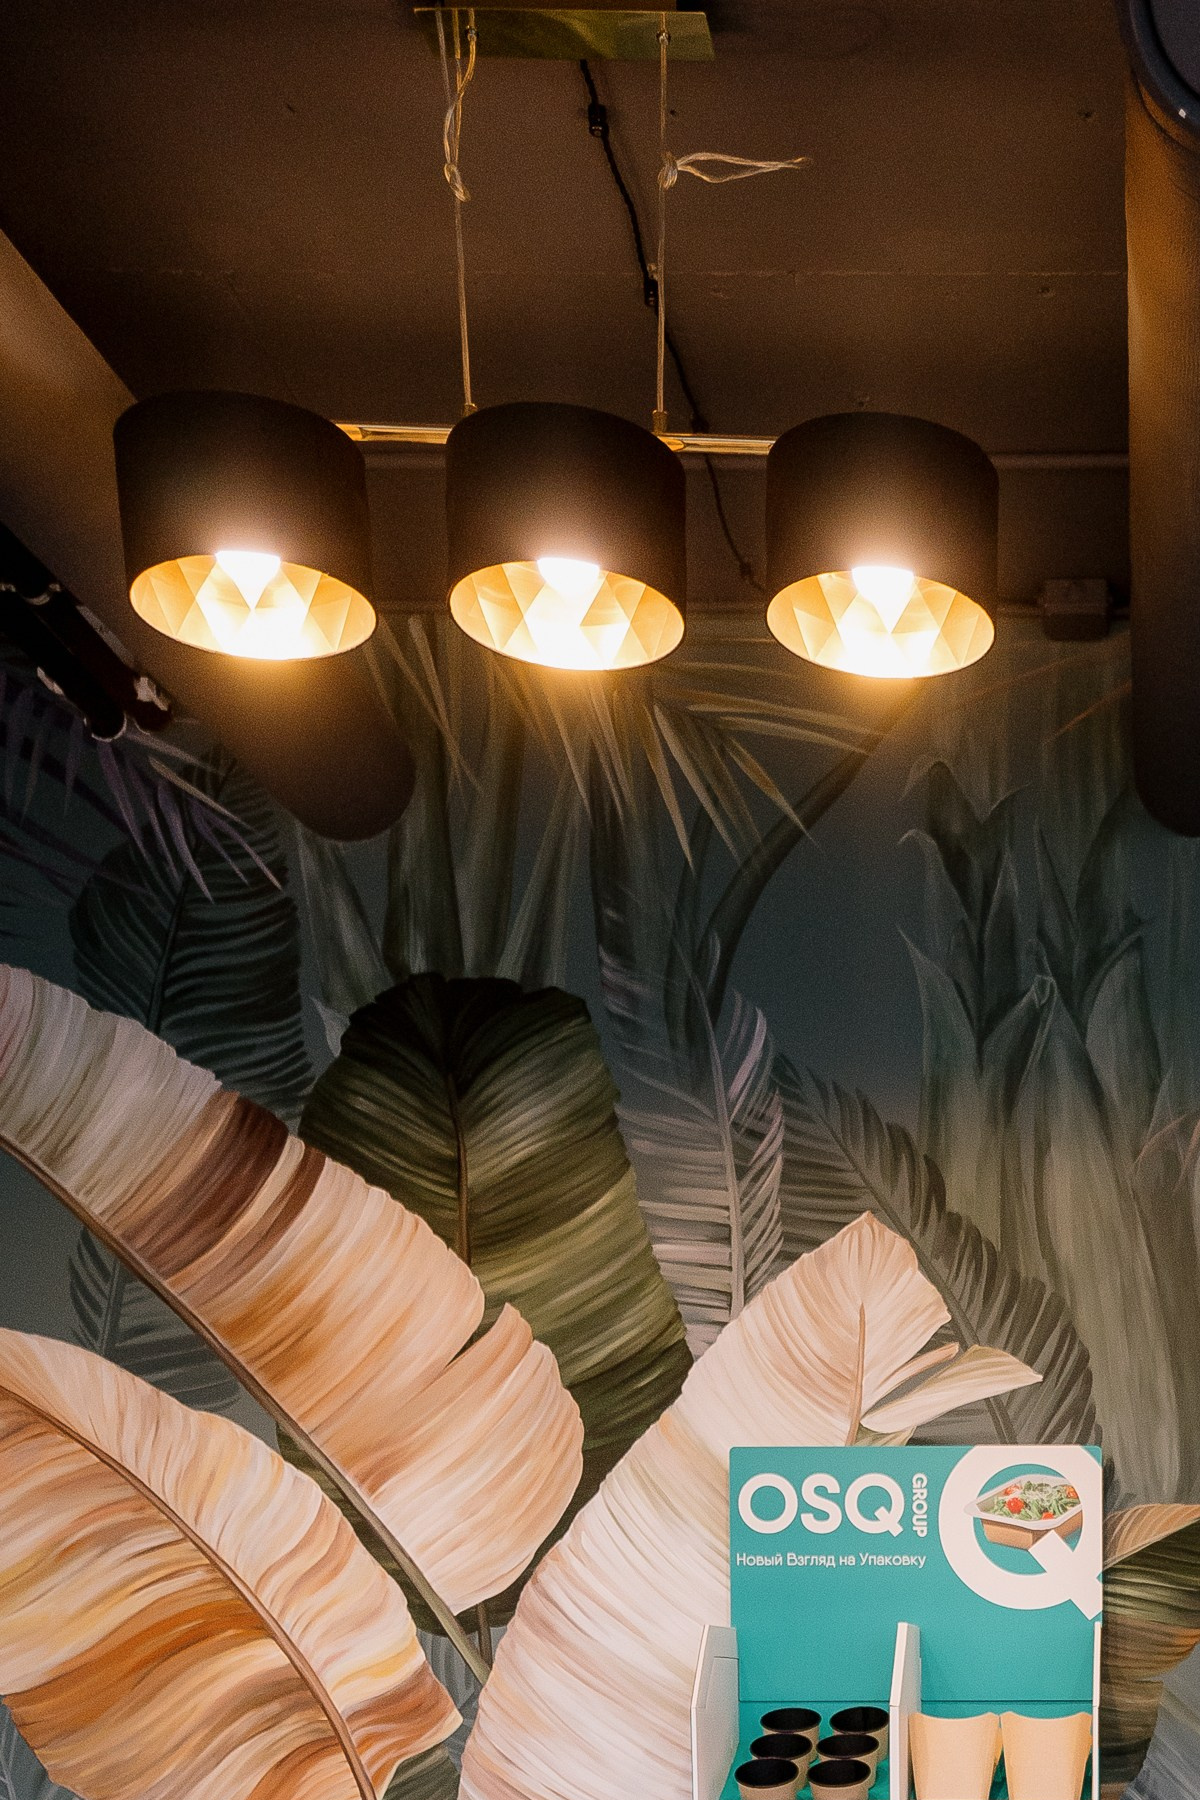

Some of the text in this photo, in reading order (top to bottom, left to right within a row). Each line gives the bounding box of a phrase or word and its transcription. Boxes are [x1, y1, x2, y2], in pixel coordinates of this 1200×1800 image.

[738, 1472, 905, 1538] OSQ
[911, 1472, 929, 1538] GROUP
[736, 1552, 927, 1569] Новый Взгляд на Упаковку
